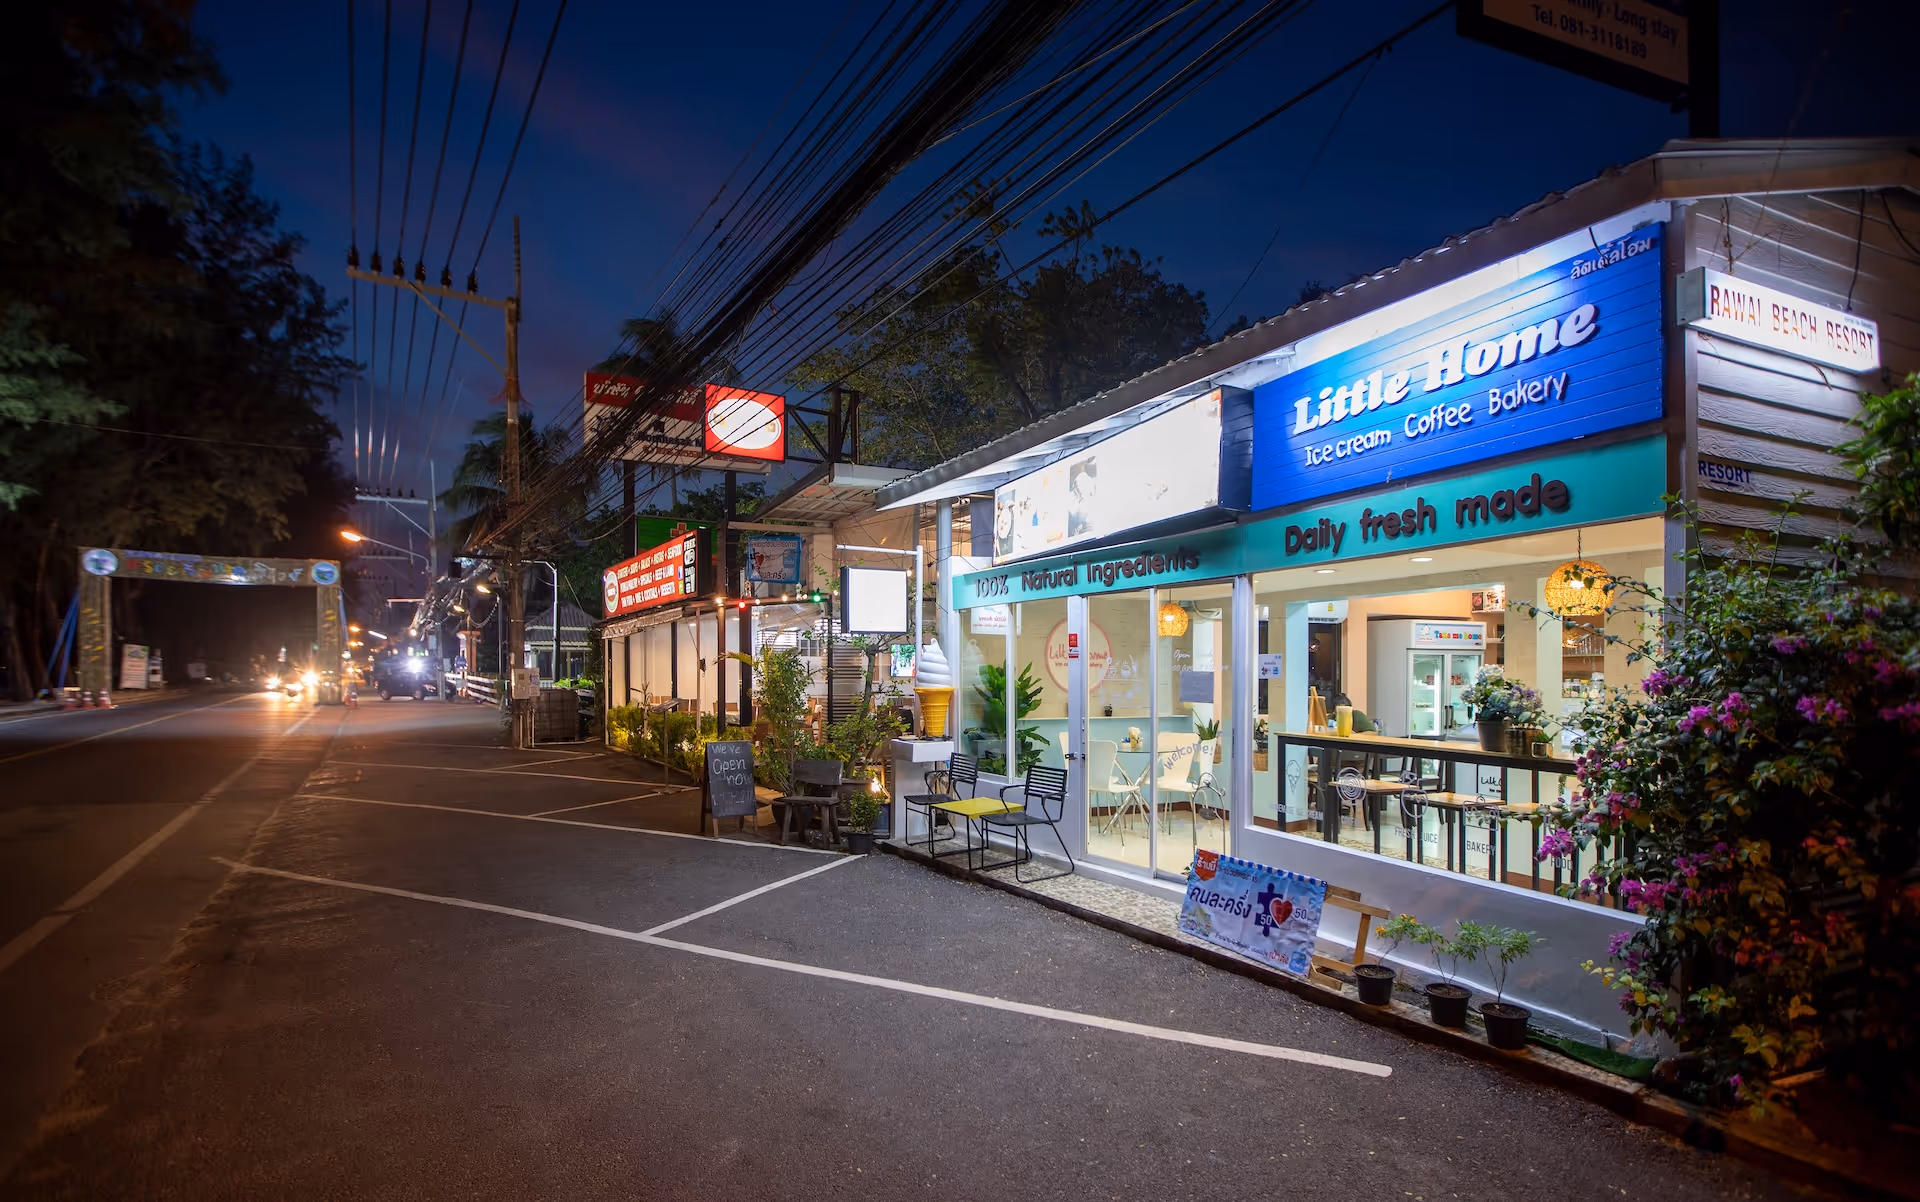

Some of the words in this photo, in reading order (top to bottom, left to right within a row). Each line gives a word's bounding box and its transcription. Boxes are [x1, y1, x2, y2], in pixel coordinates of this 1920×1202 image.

[1613, 3, 1647, 36] Long
[1710, 284, 1761, 327] RAWAI
[1772, 302, 1818, 344] BEACH
[1826, 320, 1874, 359] RESORT
[1292, 369, 1411, 436] Little
[1423, 303, 1598, 392] Home
[1335, 429, 1391, 460] cream
[1404, 403, 1473, 439] Coffee
[1488, 371, 1569, 416] Bakery
[1698, 460, 1752, 483] RESORT
[1284, 516, 1347, 556] Daily
[1359, 496, 1436, 542] fresh
[1455, 473, 1570, 526] made
[976, 574, 1009, 598] 100%
[1021, 561, 1078, 592] Natural
[1087, 545, 1200, 587] Ingredients
[712, 758, 747, 780] Open
[726, 773, 752, 787] now
[1189, 887, 1253, 919] คนละครึ่ง
[1295, 908, 1308, 920] 50
[1260, 914, 1273, 926] 50
